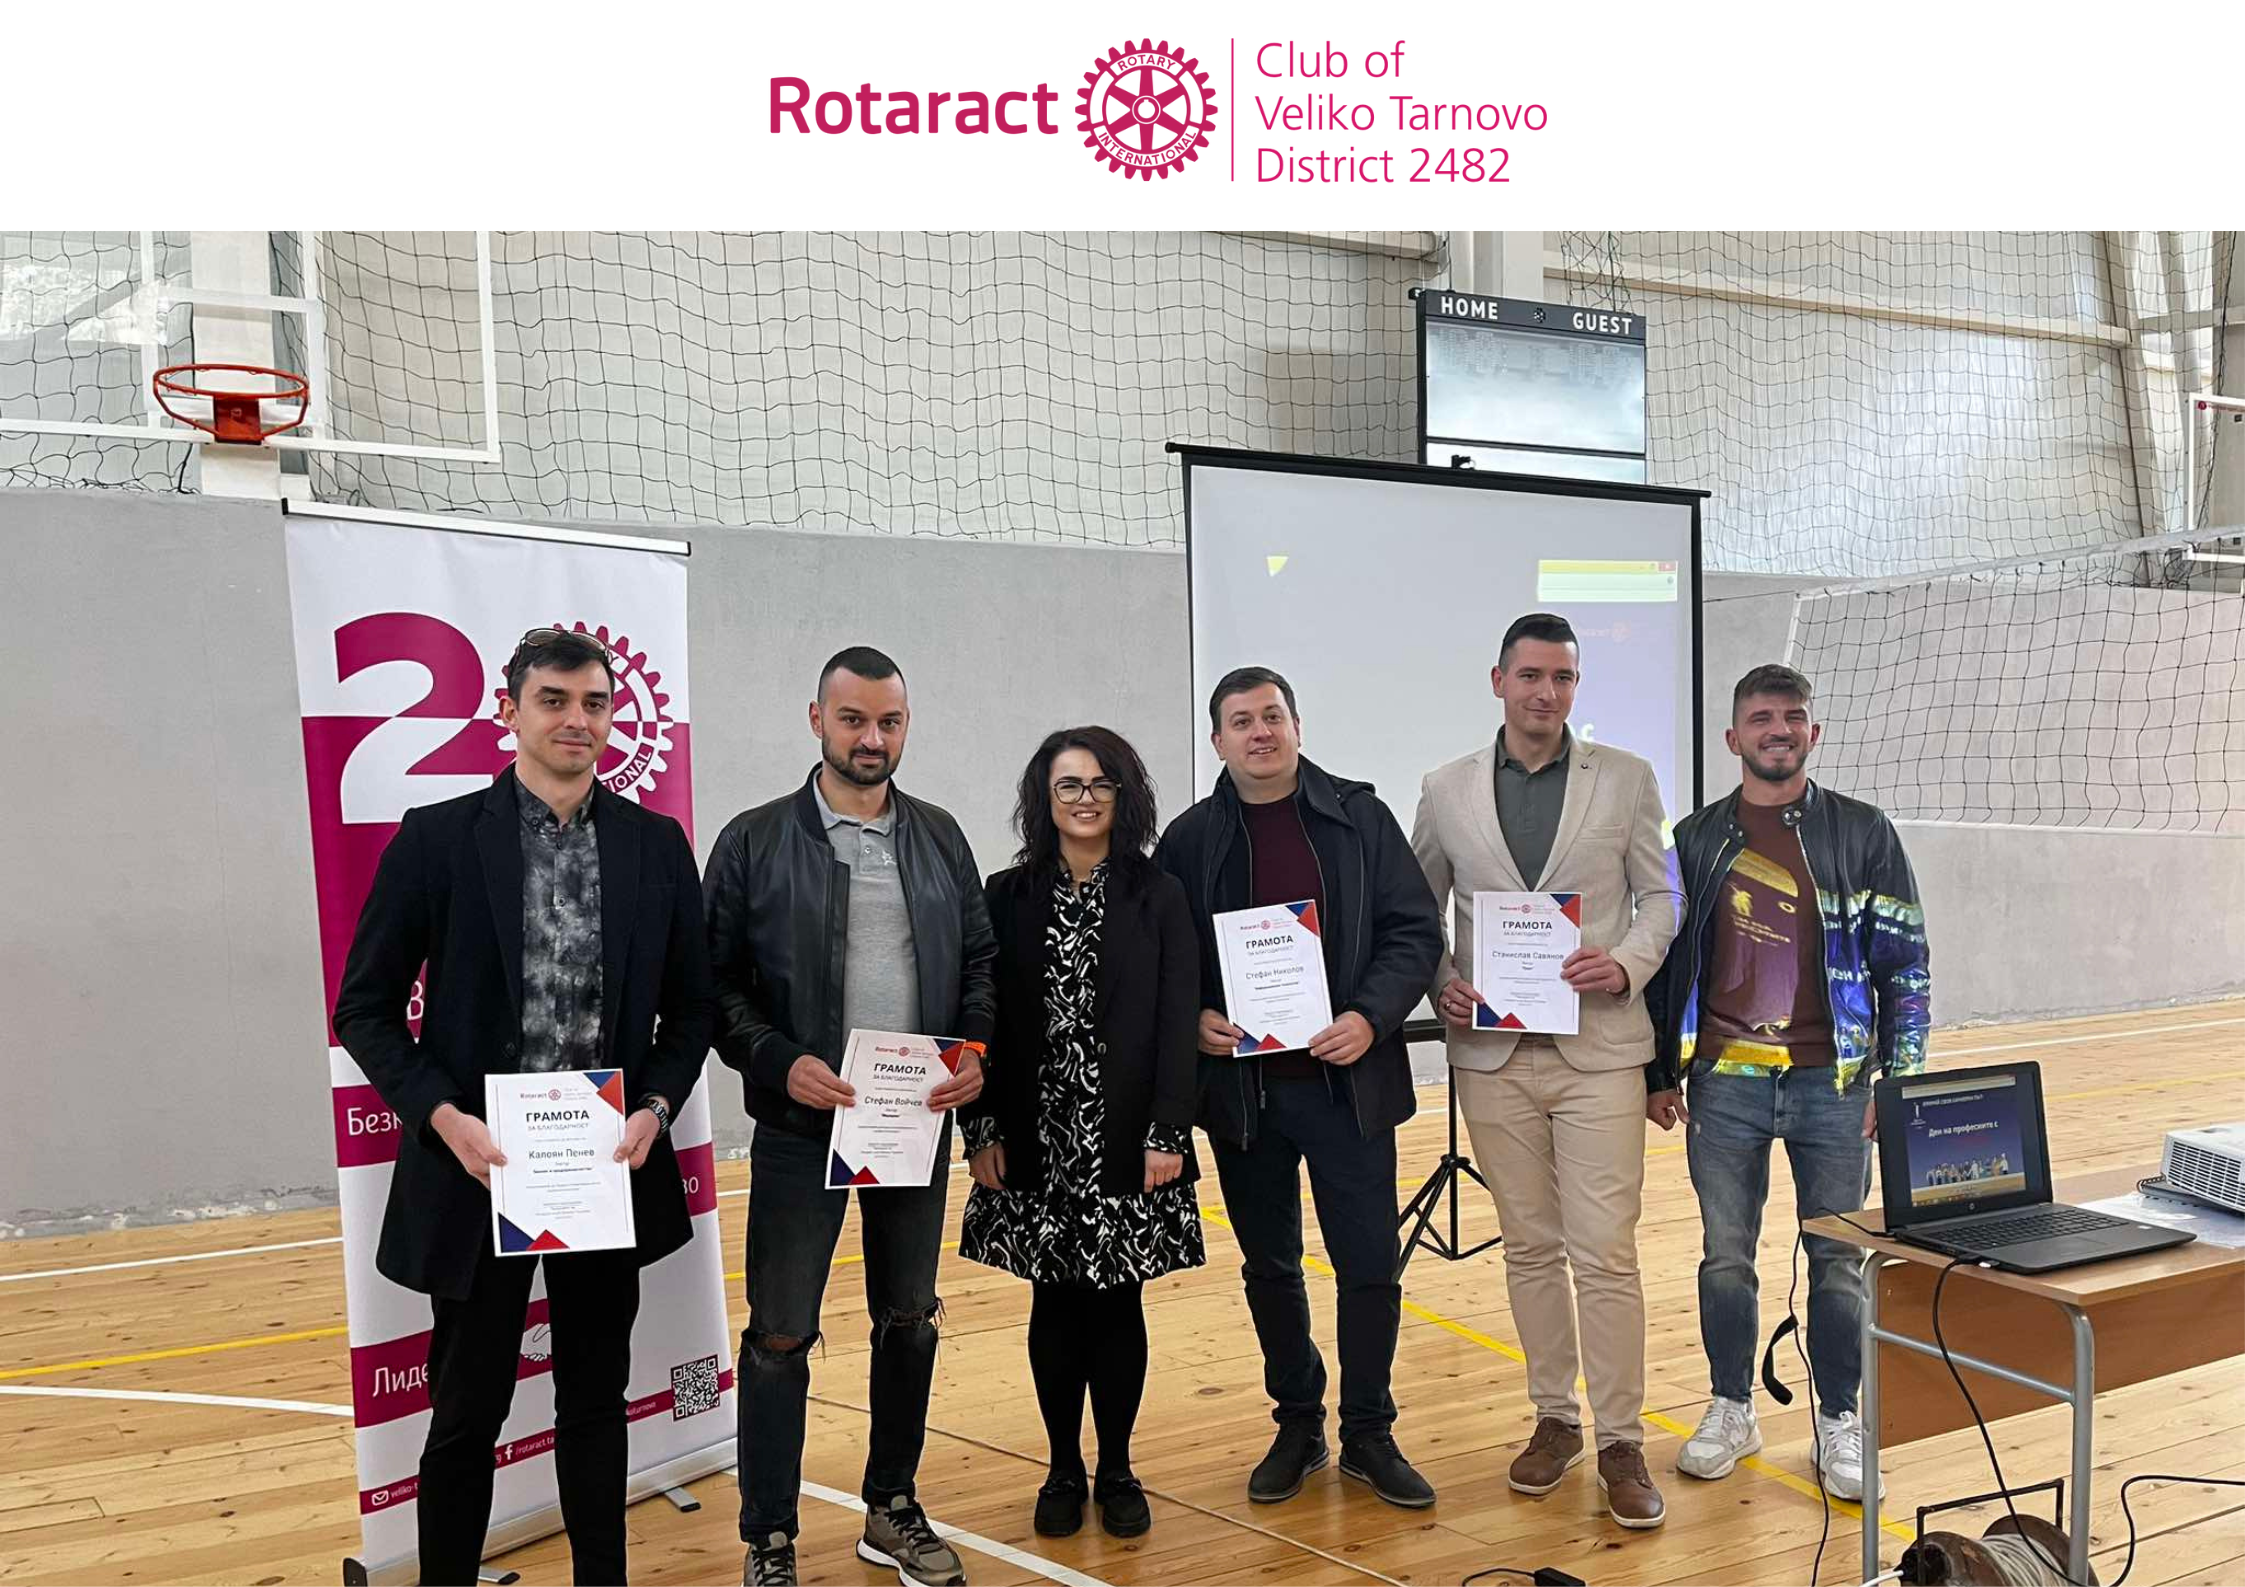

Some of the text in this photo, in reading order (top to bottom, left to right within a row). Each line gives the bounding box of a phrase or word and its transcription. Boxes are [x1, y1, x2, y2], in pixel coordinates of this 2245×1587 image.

[1440, 296, 1499, 320] HOME
[1572, 311, 1633, 335] GUEST
[1502, 921, 1553, 930] ГРАМОТА
[1245, 935, 1294, 949] ГРАМОТА
[873, 1063, 926, 1075] ГРАМОТА
[864, 1096, 893, 1106] Стефан
[526, 1110, 590, 1122] ГРАМОТА
[529, 1148, 595, 1160] Калоян Пенев
